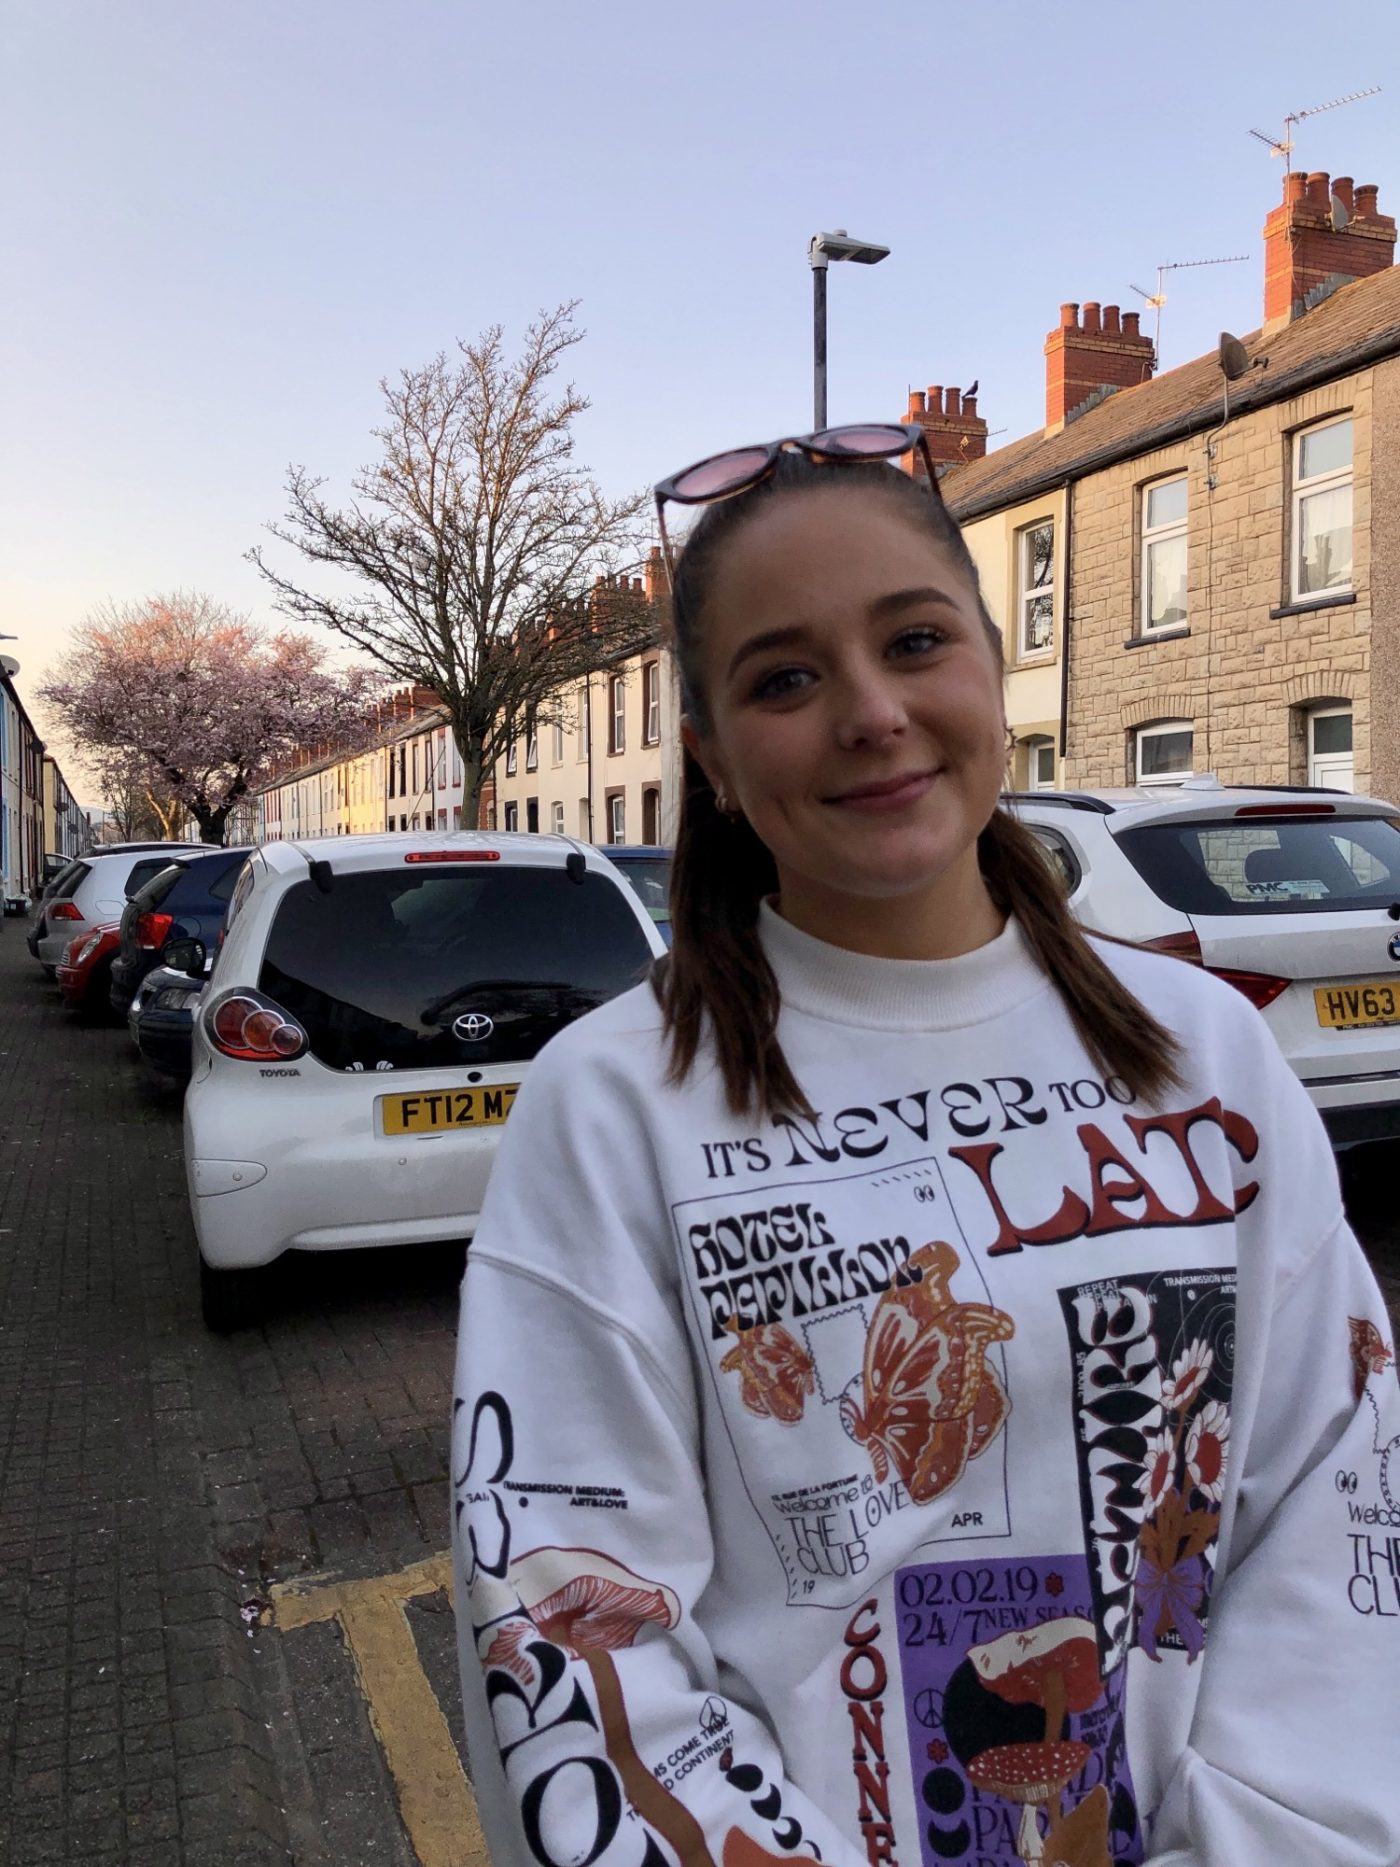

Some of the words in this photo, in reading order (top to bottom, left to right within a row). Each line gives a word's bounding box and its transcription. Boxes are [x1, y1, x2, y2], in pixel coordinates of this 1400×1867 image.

[1246, 882, 1288, 894] PMC
[1326, 988, 1395, 1020] HV63
[259, 1068, 301, 1078] TOYOTA
[402, 1093, 473, 1127] FT12
[701, 1137, 771, 1178] IT'S
[772, 1077, 1047, 1166] NEVER
[1049, 1076, 1136, 1112] TOO
[1077, 1279, 1119, 1297] REPEAT
[504, 1480, 573, 1495] TRANSMISSION
[575, 1485, 625, 1498] MEDIUM:
[784, 1513, 843, 1548] THE
[849, 1480, 910, 1540] LOVE
[951, 1511, 984, 1528] APR
[797, 1539, 869, 1577] CLUB
[901, 1566, 1038, 1608] 02.02.19
[1347, 1573, 1400, 1617] CL
[904, 1610, 985, 1647] 24/7
[984, 1606, 1028, 1629] NEW
[667, 1736, 701, 1767] COME
[674, 1729, 734, 1781] CONTINENT
